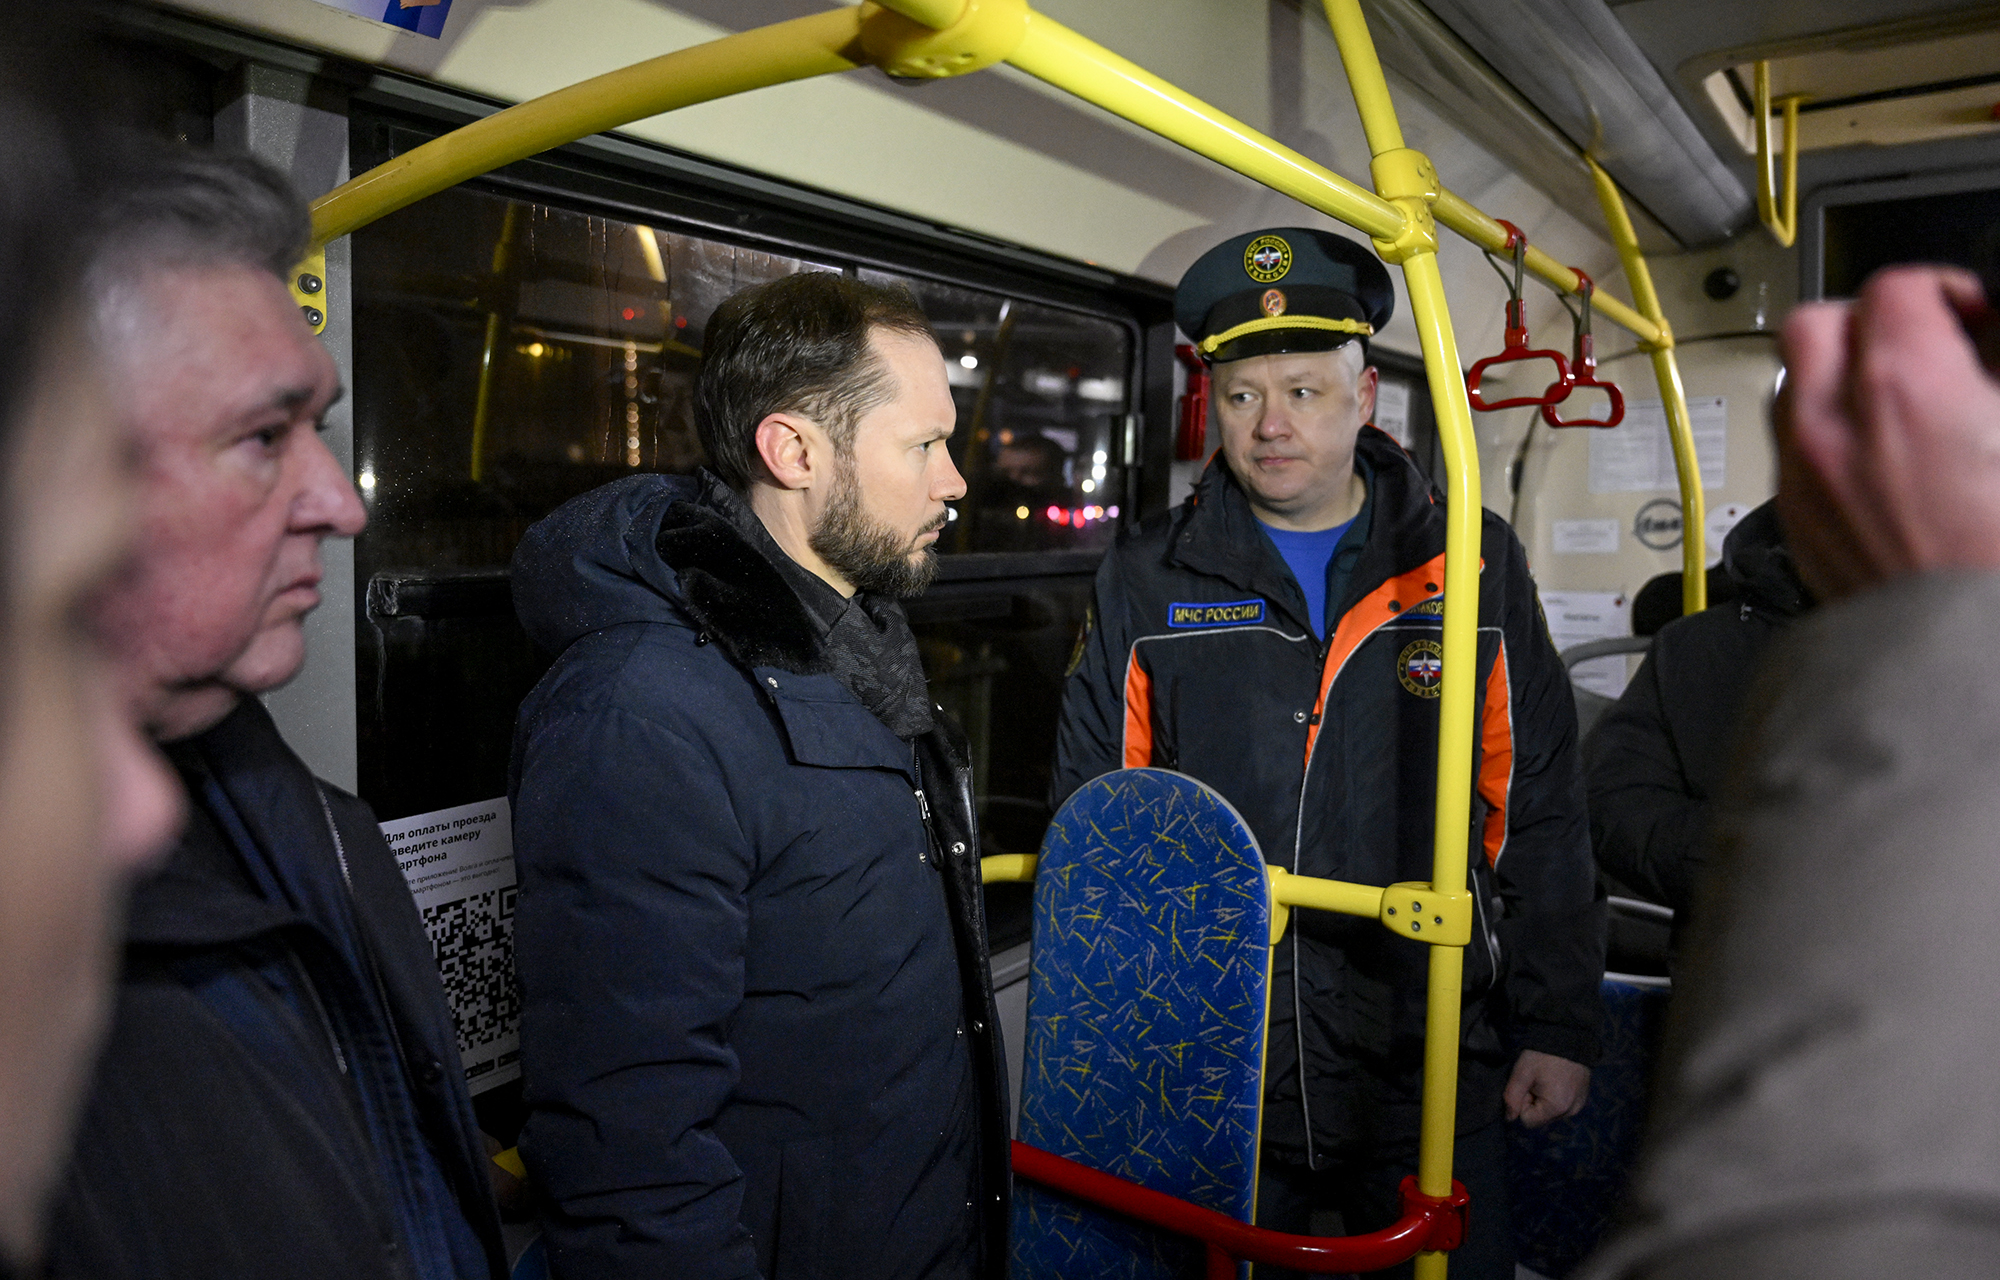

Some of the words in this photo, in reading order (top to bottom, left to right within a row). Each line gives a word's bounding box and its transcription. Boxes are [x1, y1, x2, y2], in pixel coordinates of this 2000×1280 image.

[1174, 607, 1203, 623] МЧС
[1205, 604, 1259, 622] РОССИИ
[384, 832, 405, 845] Для
[408, 822, 450, 838] оплаты
[453, 811, 497, 828] проезда
[391, 839, 438, 857] аведите
[441, 829, 481, 846] камеру
[399, 851, 447, 871] артфона
[417, 868, 458, 884] приложение
